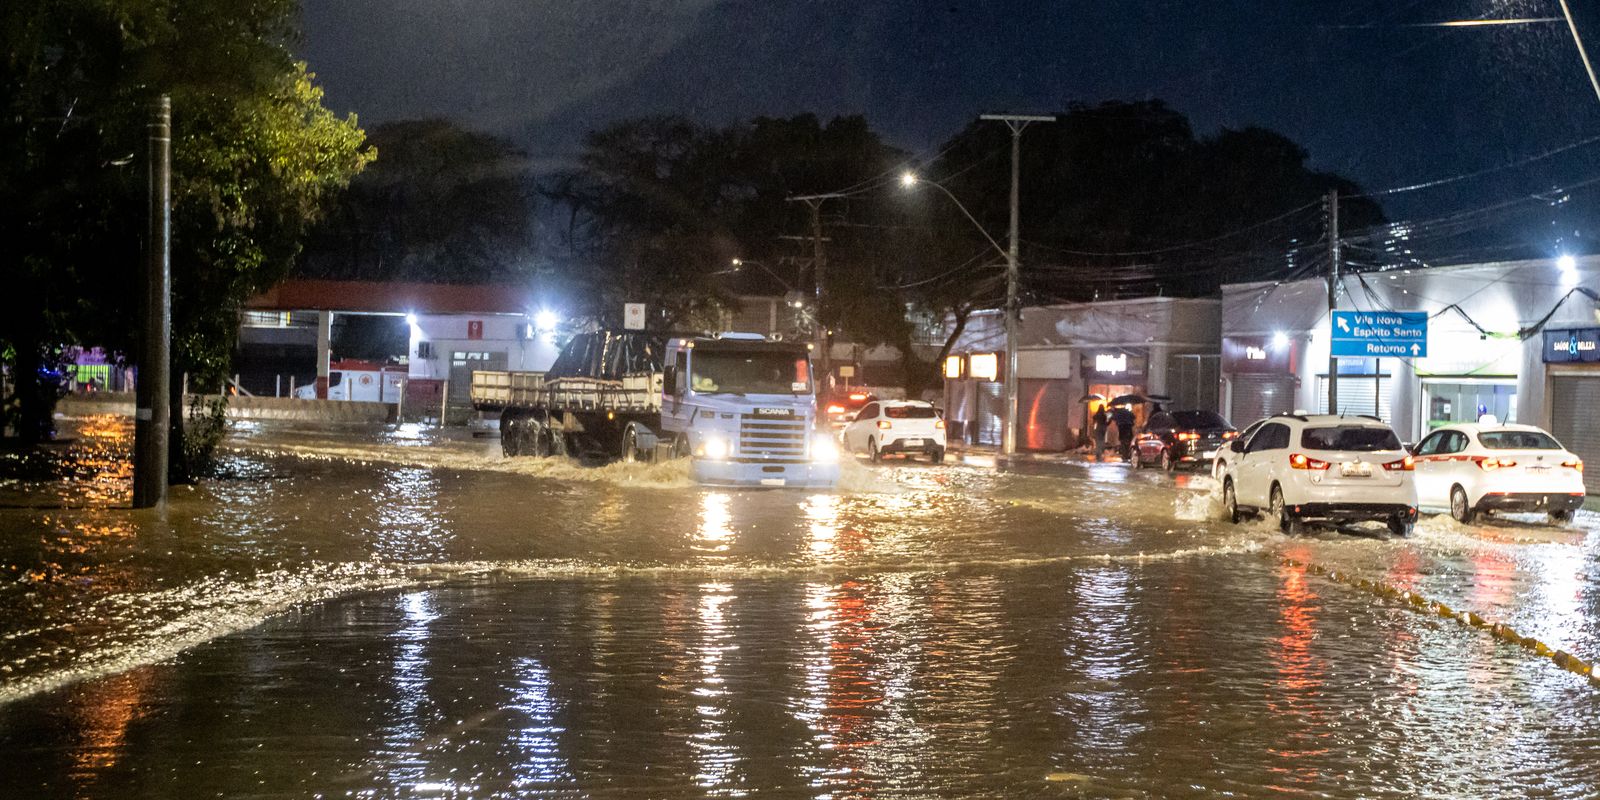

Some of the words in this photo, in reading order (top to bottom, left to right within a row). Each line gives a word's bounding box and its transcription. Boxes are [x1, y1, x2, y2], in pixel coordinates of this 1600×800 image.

[1354, 315, 1373, 325] Vila
[1377, 316, 1402, 325] Nova
[1393, 327, 1422, 337] Santo
